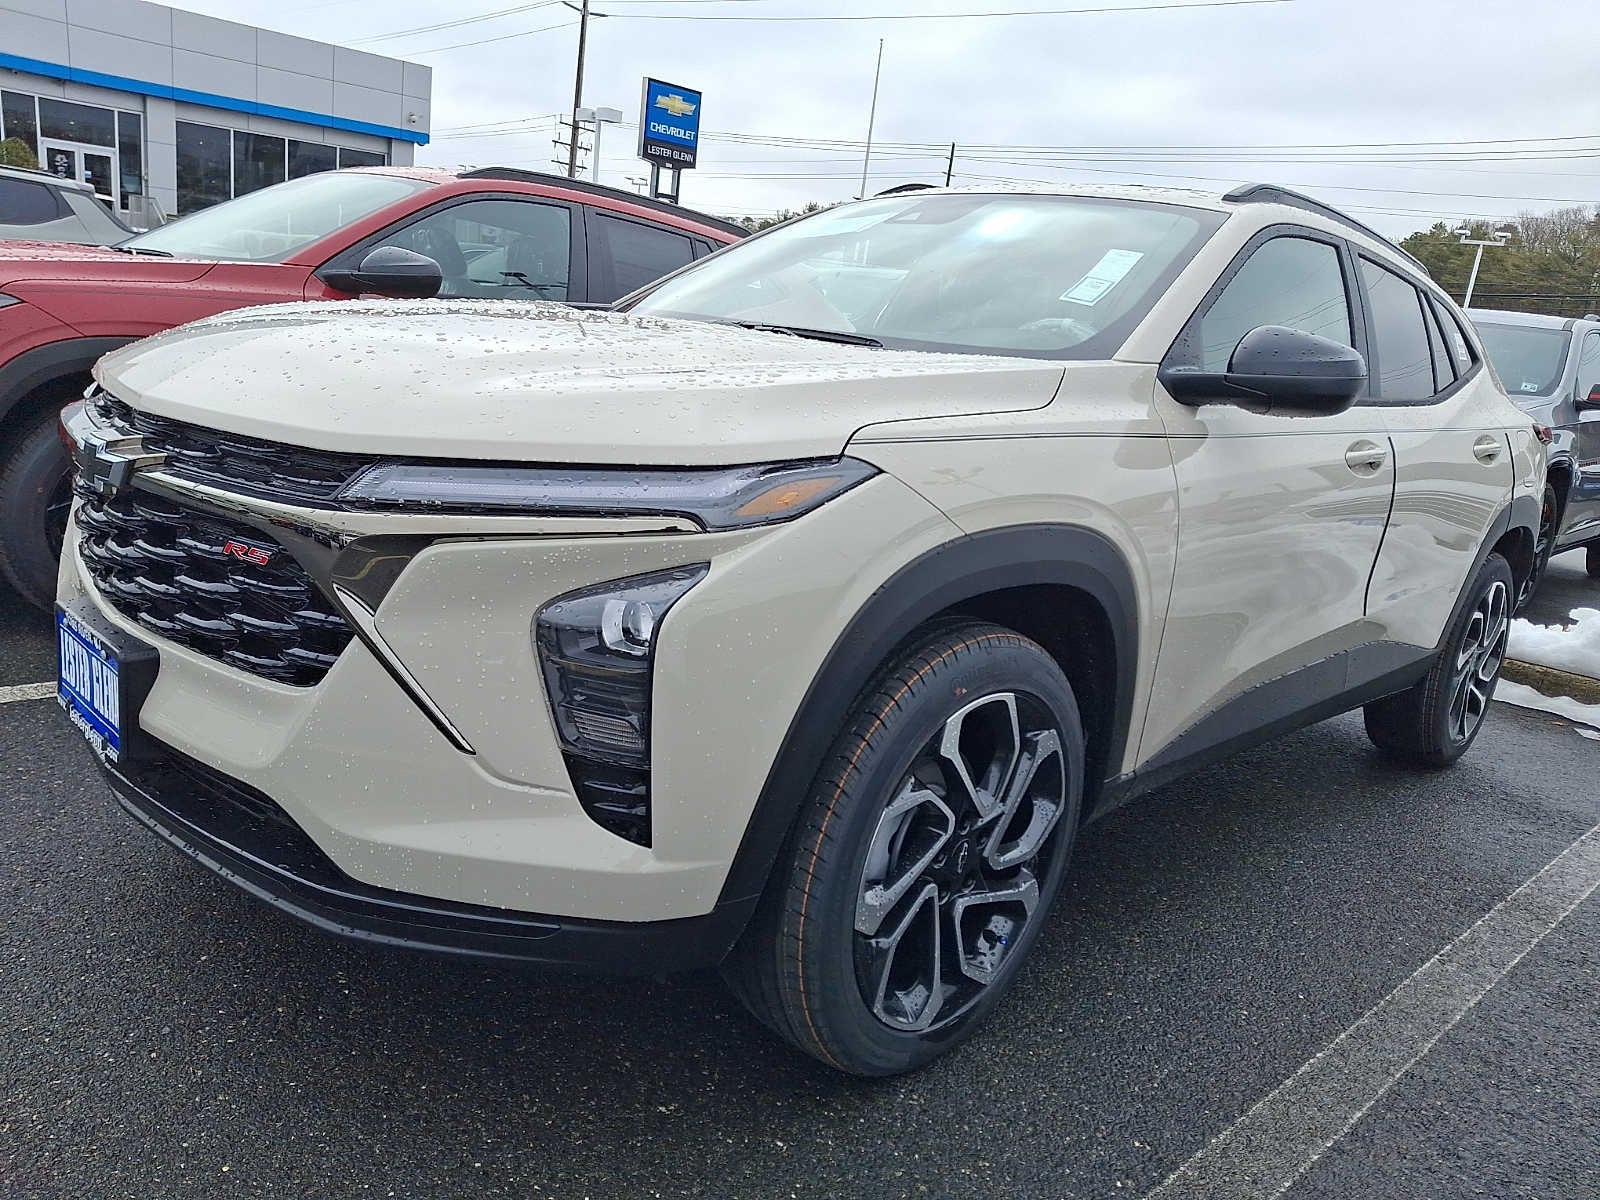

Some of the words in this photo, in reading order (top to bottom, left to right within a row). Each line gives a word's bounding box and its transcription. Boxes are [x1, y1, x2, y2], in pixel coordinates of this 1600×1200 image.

[650, 121, 696, 140] CHEVROLET
[647, 144, 672, 158] LESTER
[673, 150, 694, 162] GLENN
[223, 540, 272, 566] RS
[60, 628, 91, 703] LESTER
[91, 654, 119, 730] GLENN
